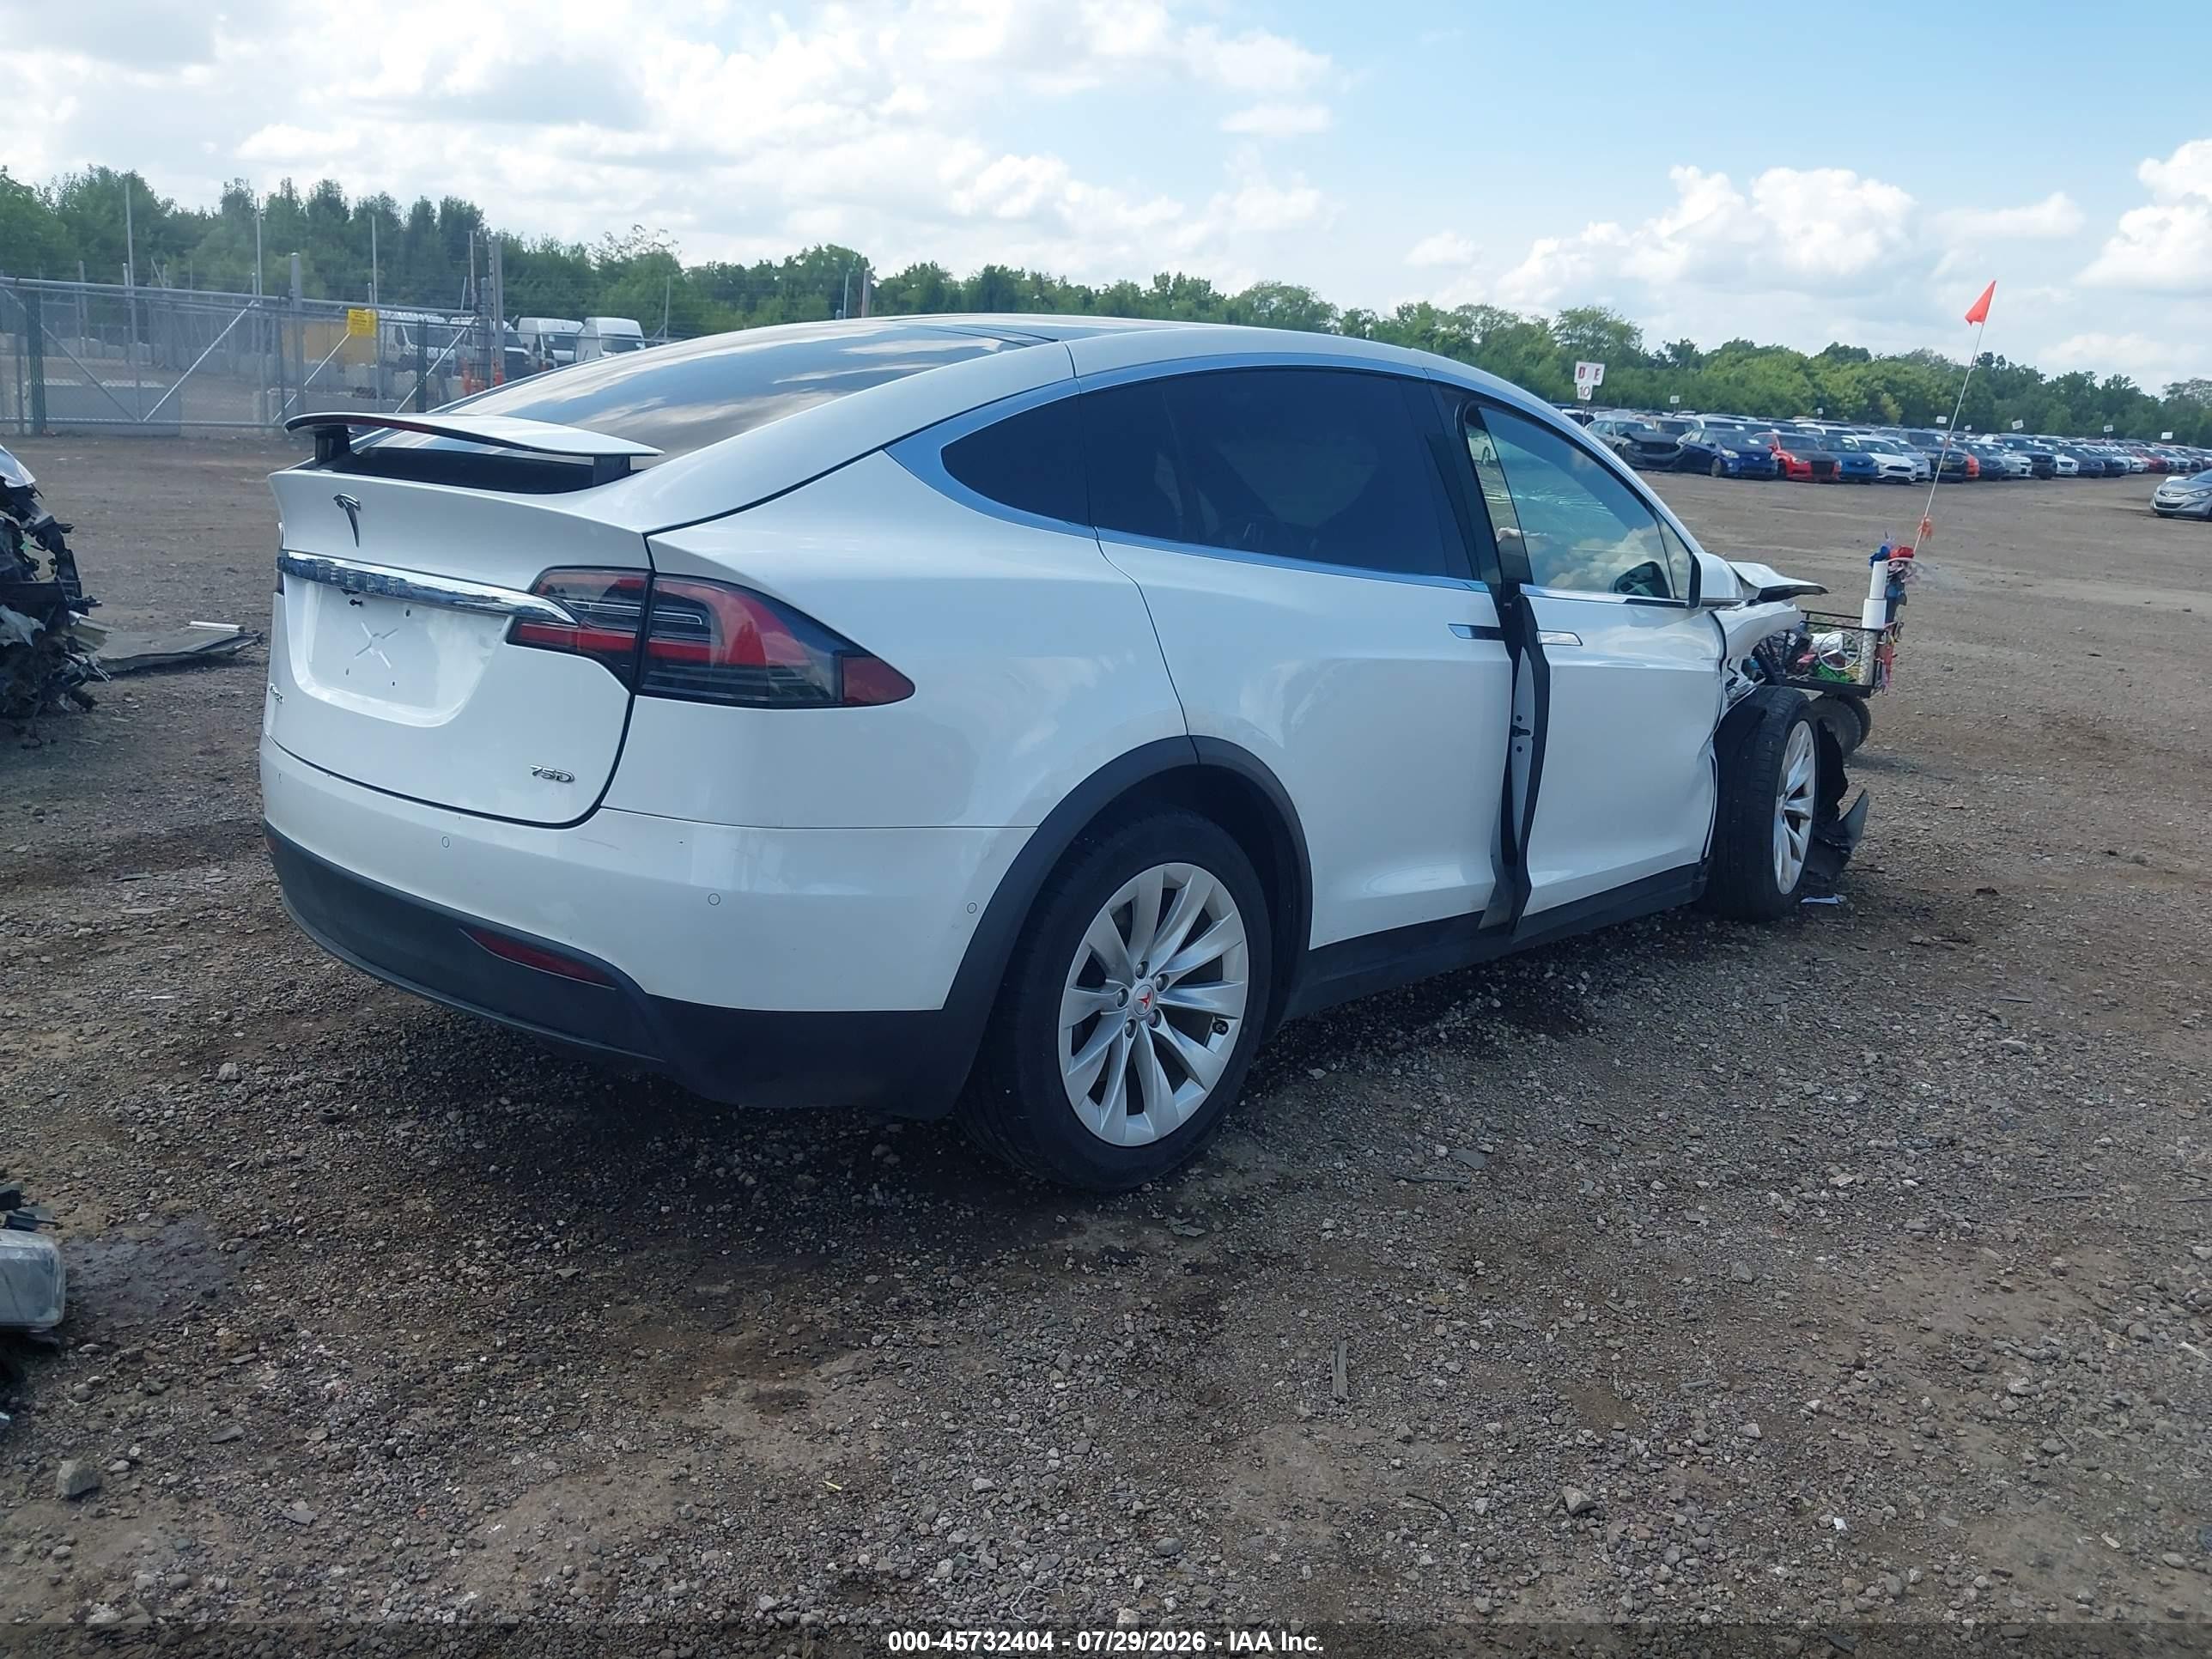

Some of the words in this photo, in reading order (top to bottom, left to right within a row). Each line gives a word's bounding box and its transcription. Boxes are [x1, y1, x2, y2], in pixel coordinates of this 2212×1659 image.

[1594, 368, 1601, 380] E
[1580, 386, 1590, 397] 10
[530, 764, 574, 782] 75D
